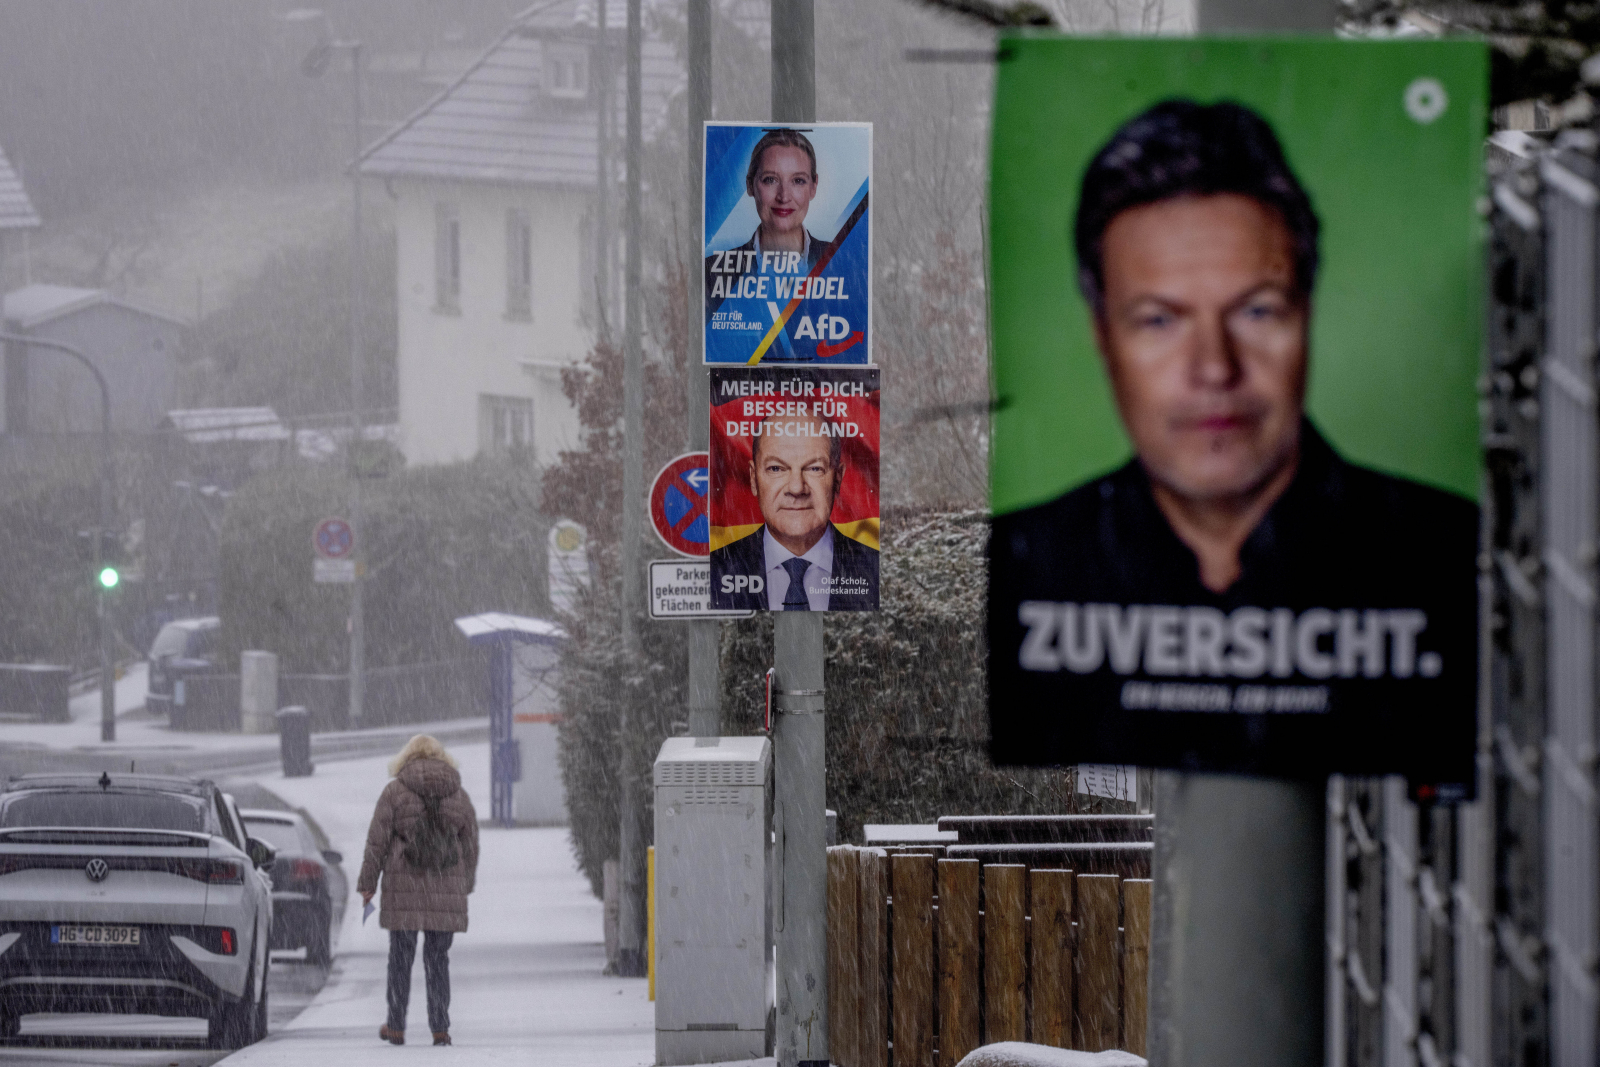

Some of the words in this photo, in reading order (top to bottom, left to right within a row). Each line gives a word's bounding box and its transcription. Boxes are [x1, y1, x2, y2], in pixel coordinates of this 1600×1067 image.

[711, 250, 757, 273] ZEIT
[711, 276, 769, 298] ALICE
[775, 277, 849, 300] WEIDEL
[711, 312, 728, 321] ZEIT
[728, 310, 743, 321] FÜR
[711, 321, 764, 331] DEUTSCHLAND.
[794, 313, 850, 340] AfD
[721, 380, 775, 396] MEHR
[781, 378, 815, 397] FÜR
[821, 381, 870, 398] DICH.
[743, 401, 807, 417] BESSER
[813, 398, 848, 418] FÜR
[726, 421, 865, 438] DEUTSCHLAND.
[721, 575, 764, 594] SPD
[821, 576, 839, 585] Olaf
[840, 576, 869, 586] Scholz,
[809, 586, 870, 595] Bundeskanzler
[661, 599, 701, 611] Flächen
[1019, 601, 1442, 678] ZUVERSICHT.
[60, 926, 77, 942] HG
